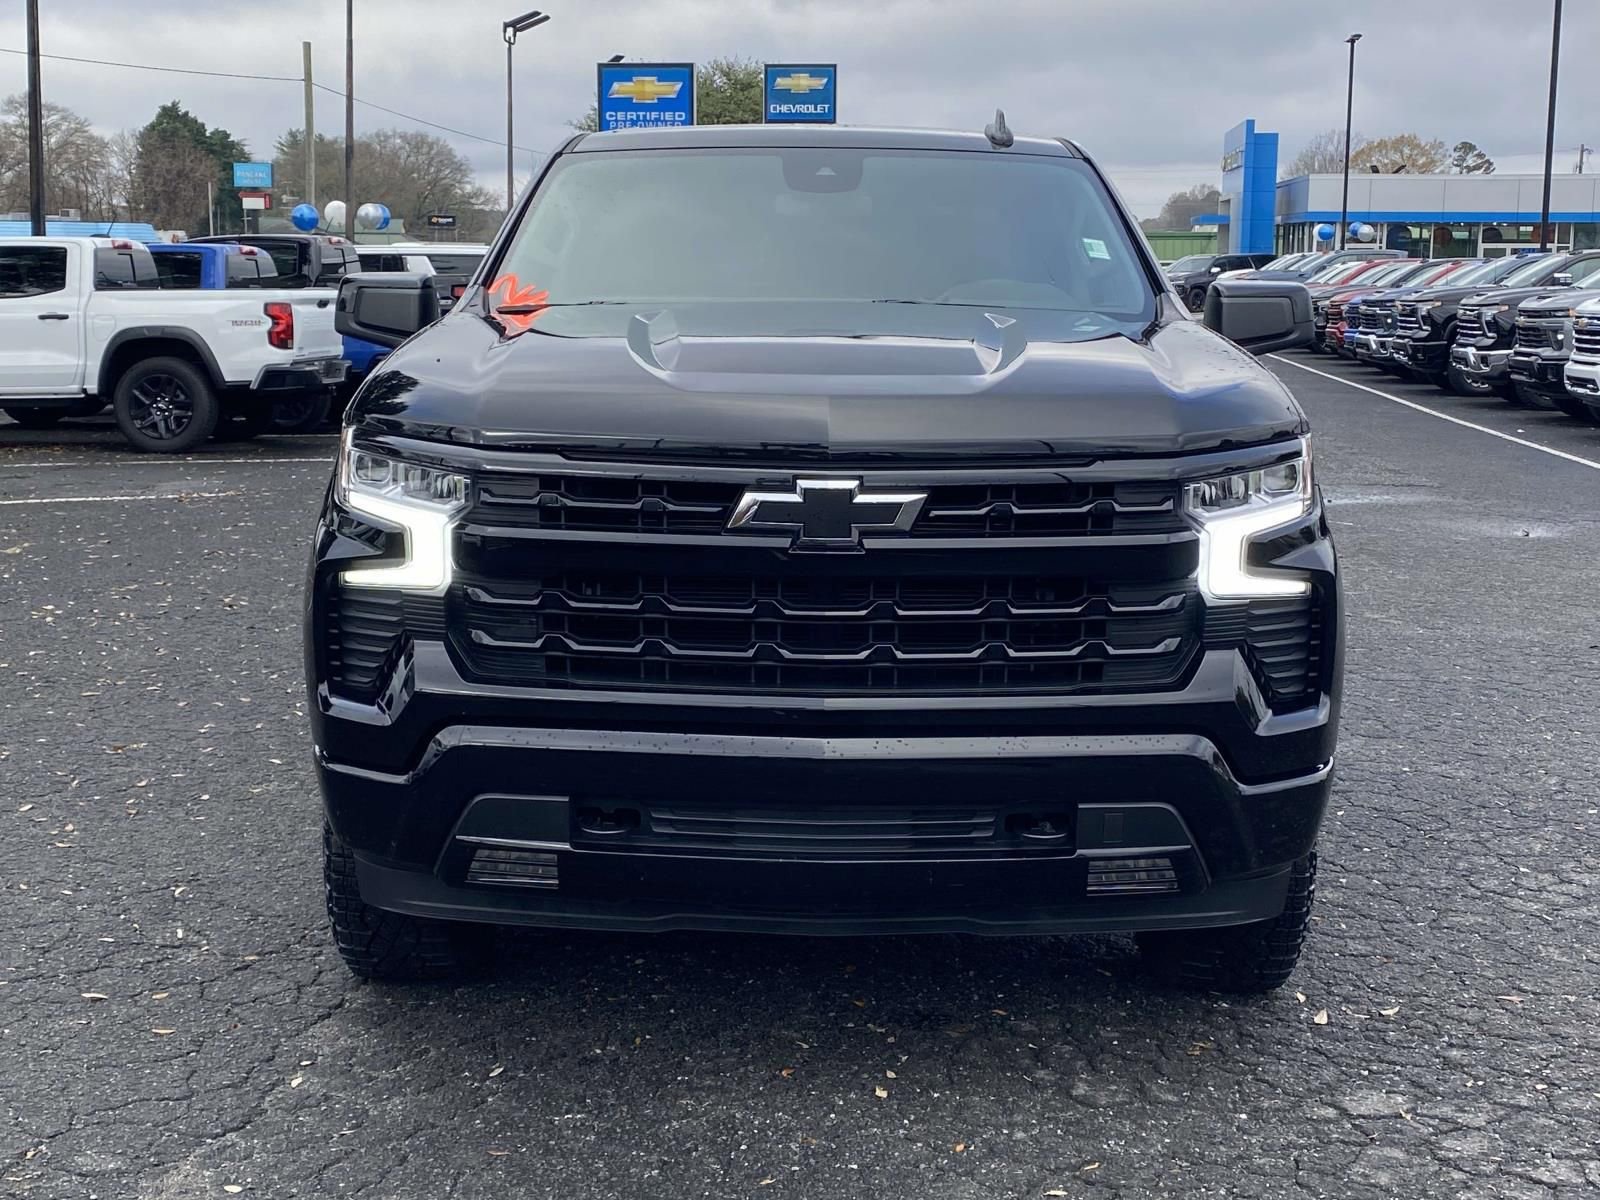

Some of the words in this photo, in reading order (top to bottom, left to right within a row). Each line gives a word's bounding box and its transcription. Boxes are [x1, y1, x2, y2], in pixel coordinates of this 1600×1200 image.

[770, 104, 830, 114] CHEVROLET
[605, 111, 686, 121] CERTIFIED
[609, 121, 682, 129] PRE-OWNED
